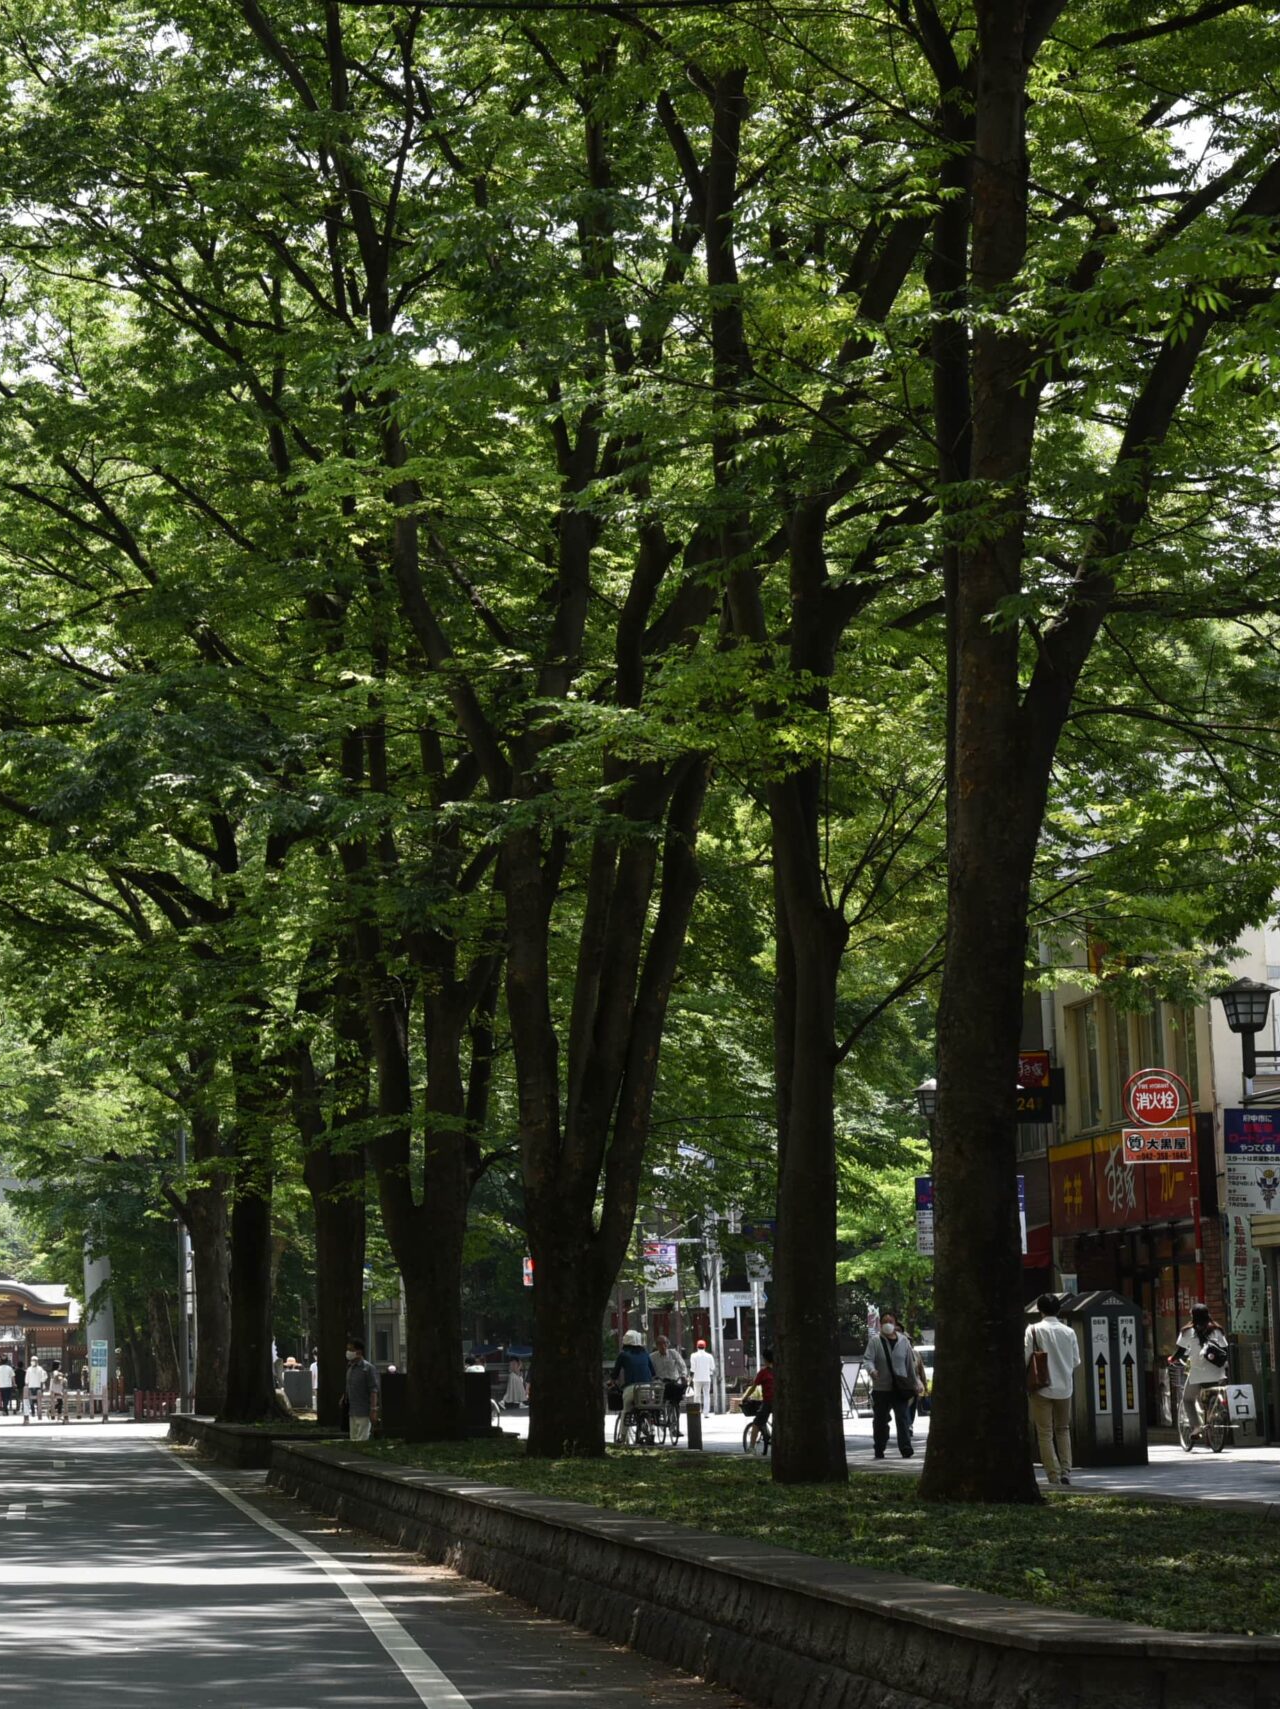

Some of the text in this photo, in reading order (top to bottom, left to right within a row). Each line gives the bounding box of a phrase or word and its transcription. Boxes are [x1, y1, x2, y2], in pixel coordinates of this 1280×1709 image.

[1136, 1090, 1175, 1110] 消火栓
[1146, 1138, 1186, 1150] 大黒屋
[1064, 1172, 1082, 1216] 牛丼
[1233, 1389, 1249, 1414] 入口
